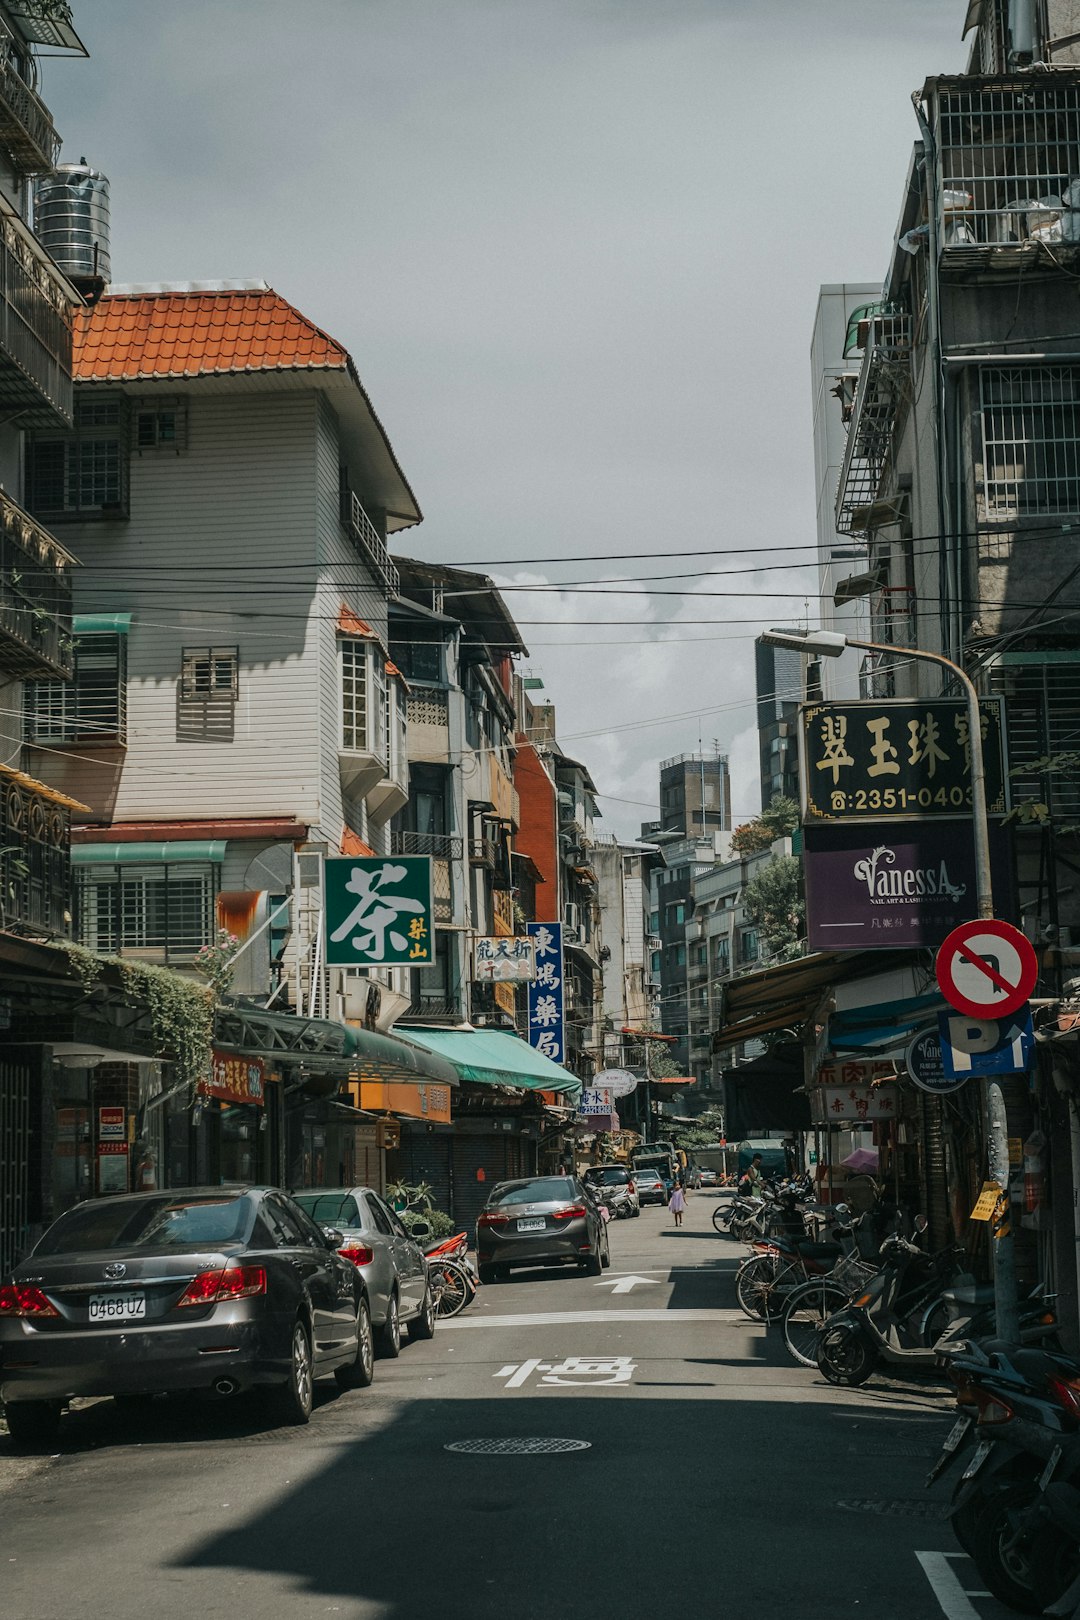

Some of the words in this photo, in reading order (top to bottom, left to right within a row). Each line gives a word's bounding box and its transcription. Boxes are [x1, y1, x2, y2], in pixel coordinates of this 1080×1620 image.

[816, 712, 990, 785] 翠玉珠寶
[330, 863, 426, 960] 茶
[408, 918, 428, 959] 梨山
[531, 926, 560, 1059] 東鴻藥局
[949, 1016, 1000, 1071] P
[491, 1356, 638, 1388] 慢
